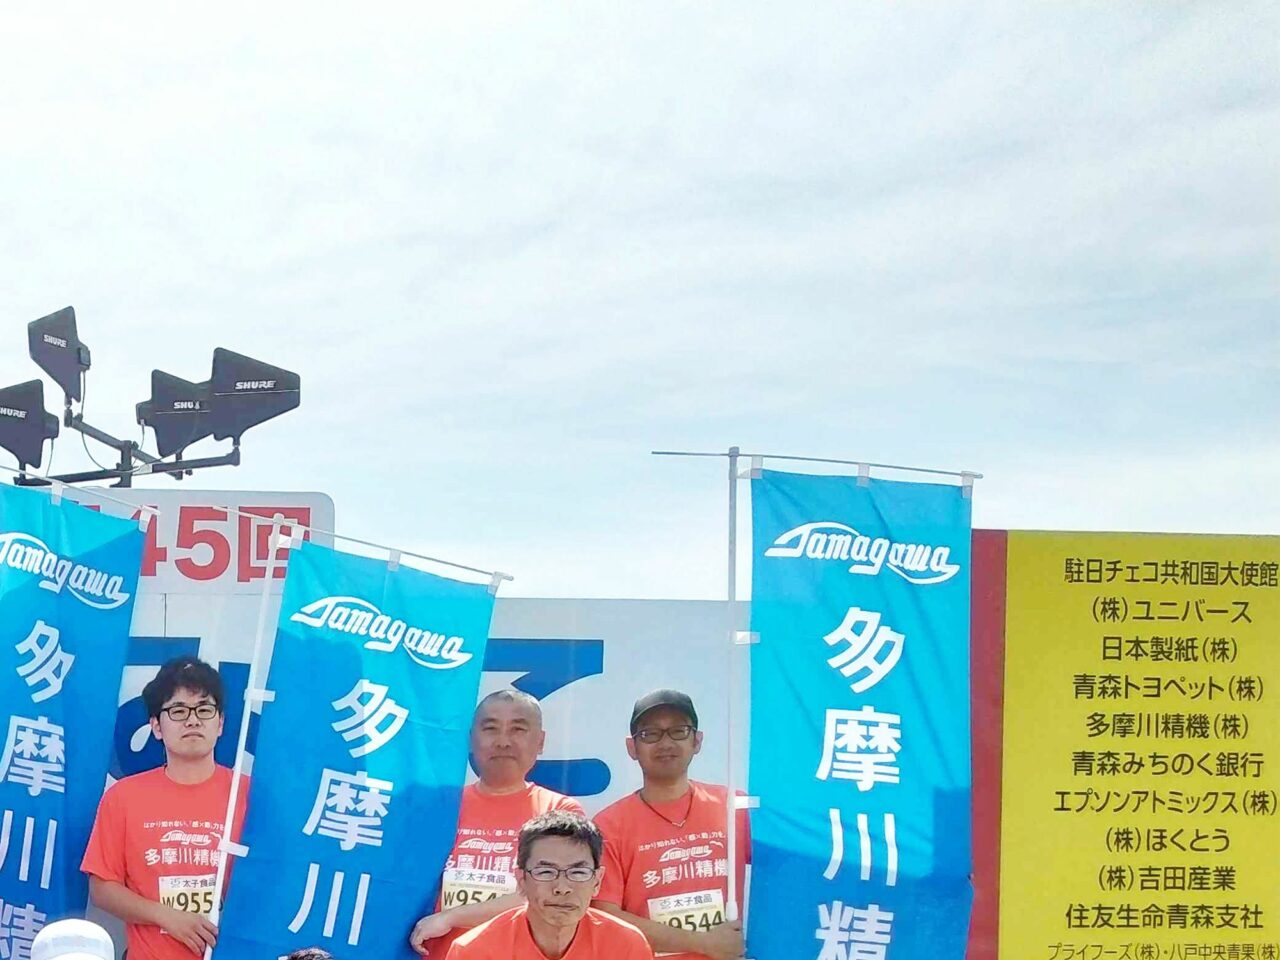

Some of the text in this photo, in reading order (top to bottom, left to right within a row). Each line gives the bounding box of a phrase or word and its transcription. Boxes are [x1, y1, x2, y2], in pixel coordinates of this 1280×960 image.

[43, 334, 68, 348] SHURE
[235, 380, 277, 390] SHURE
[764, 521, 961, 585] Tamagawa
[1064, 558, 1279, 587] 駐日チェコ共和国大使館
[1092, 597, 1252, 624] (株)ユニバース
[289, 596, 473, 670] Tamagawa
[1102, 636, 1238, 663] 日本製紙(株)
[1072, 673, 1264, 701] 青森トヨペット(株)
[1086, 712, 1249, 739] 多摩川精機(株)
[1071, 751, 1264, 778] 青森みちのく銀行
[1053, 788, 1278, 815] エプソンアトミックス(株)
[159, 829, 212, 846] Tamagawa
[1105, 827, 1230, 853] (株)ほくとう
[466, 872, 506, 884] 太子食品
[642, 858, 729, 889] 多摩川精機
[1098, 865, 1236, 891] (株)吉田産業
[162, 892, 223, 914] W955
[673, 893, 713, 908] 太子食品
[660, 910, 724, 932] 9544
[1065, 903, 1264, 929] 住友生命青森支社
